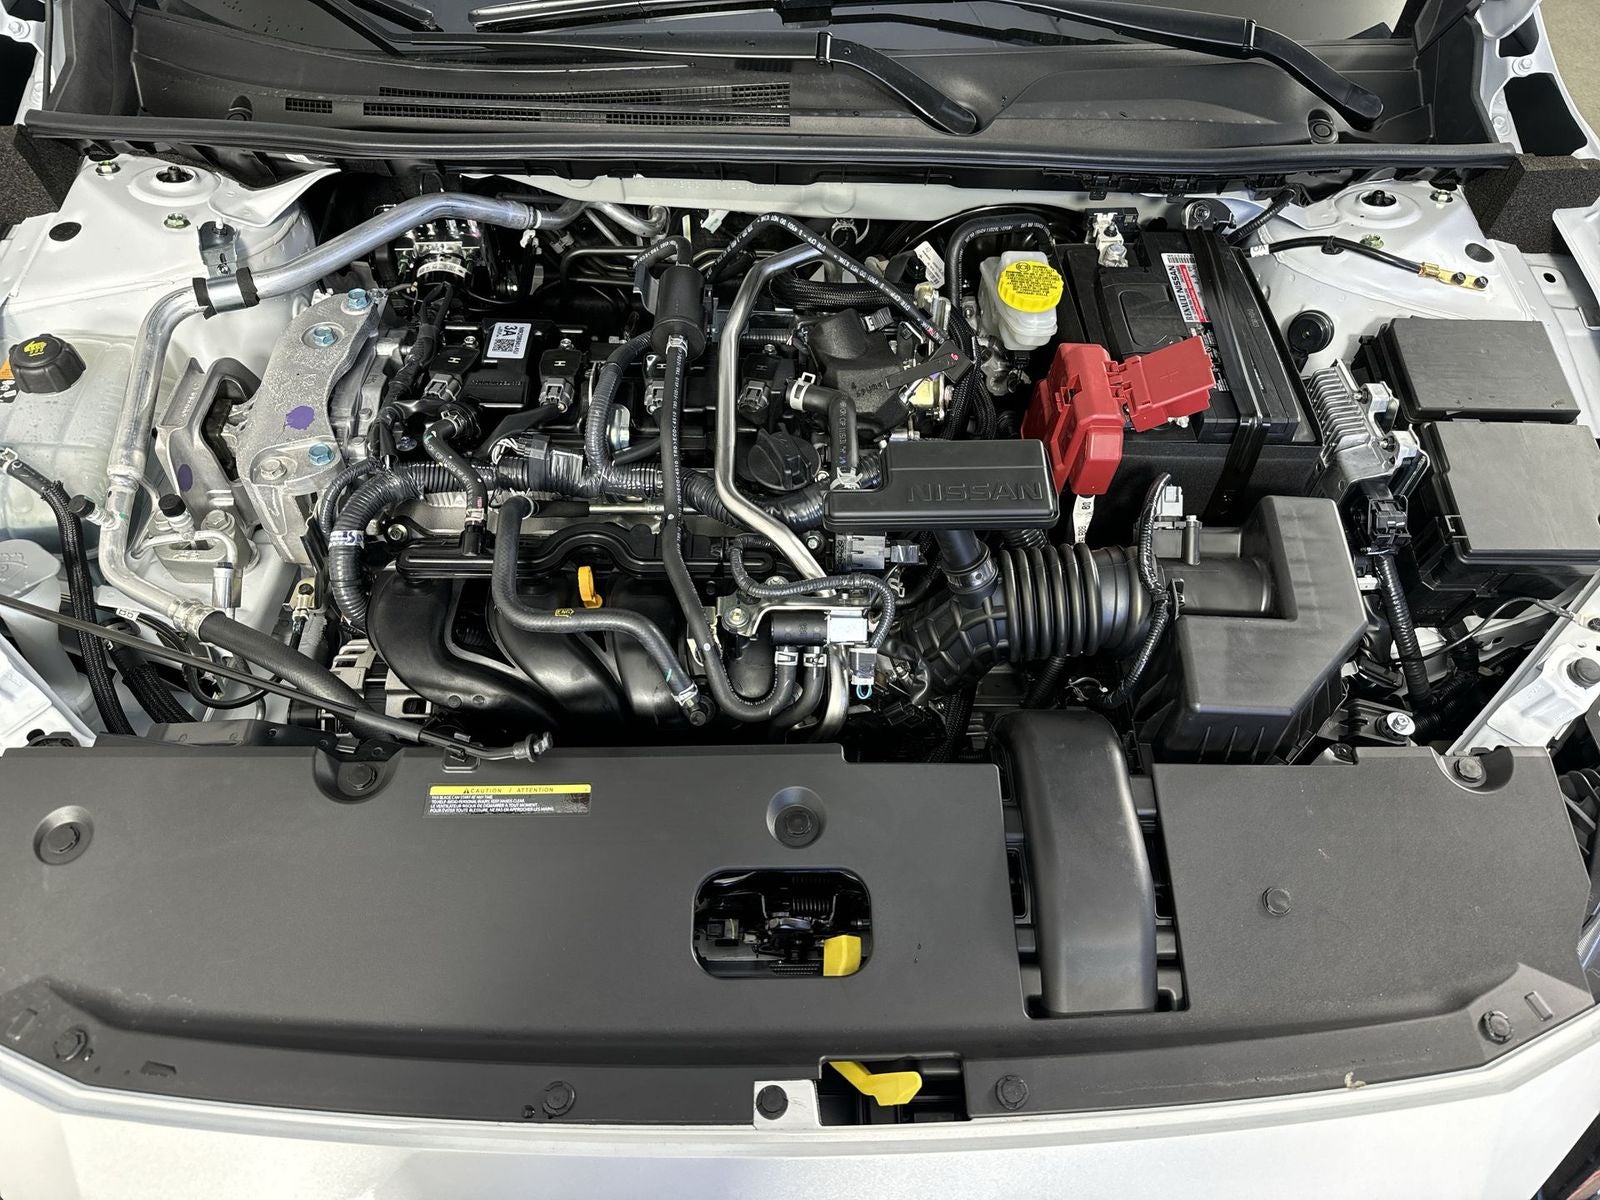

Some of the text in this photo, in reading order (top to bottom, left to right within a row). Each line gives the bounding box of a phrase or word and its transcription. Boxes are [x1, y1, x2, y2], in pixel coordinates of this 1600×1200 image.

[859, 269, 867, 278] DO
[1168, 265, 1184, 294] NISSAN
[900, 301, 911, 311] DTR
[1178, 295, 1194, 321] RENAULT
[502, 325, 518, 337] 3A
[910, 480, 1043, 502] NISSAN
